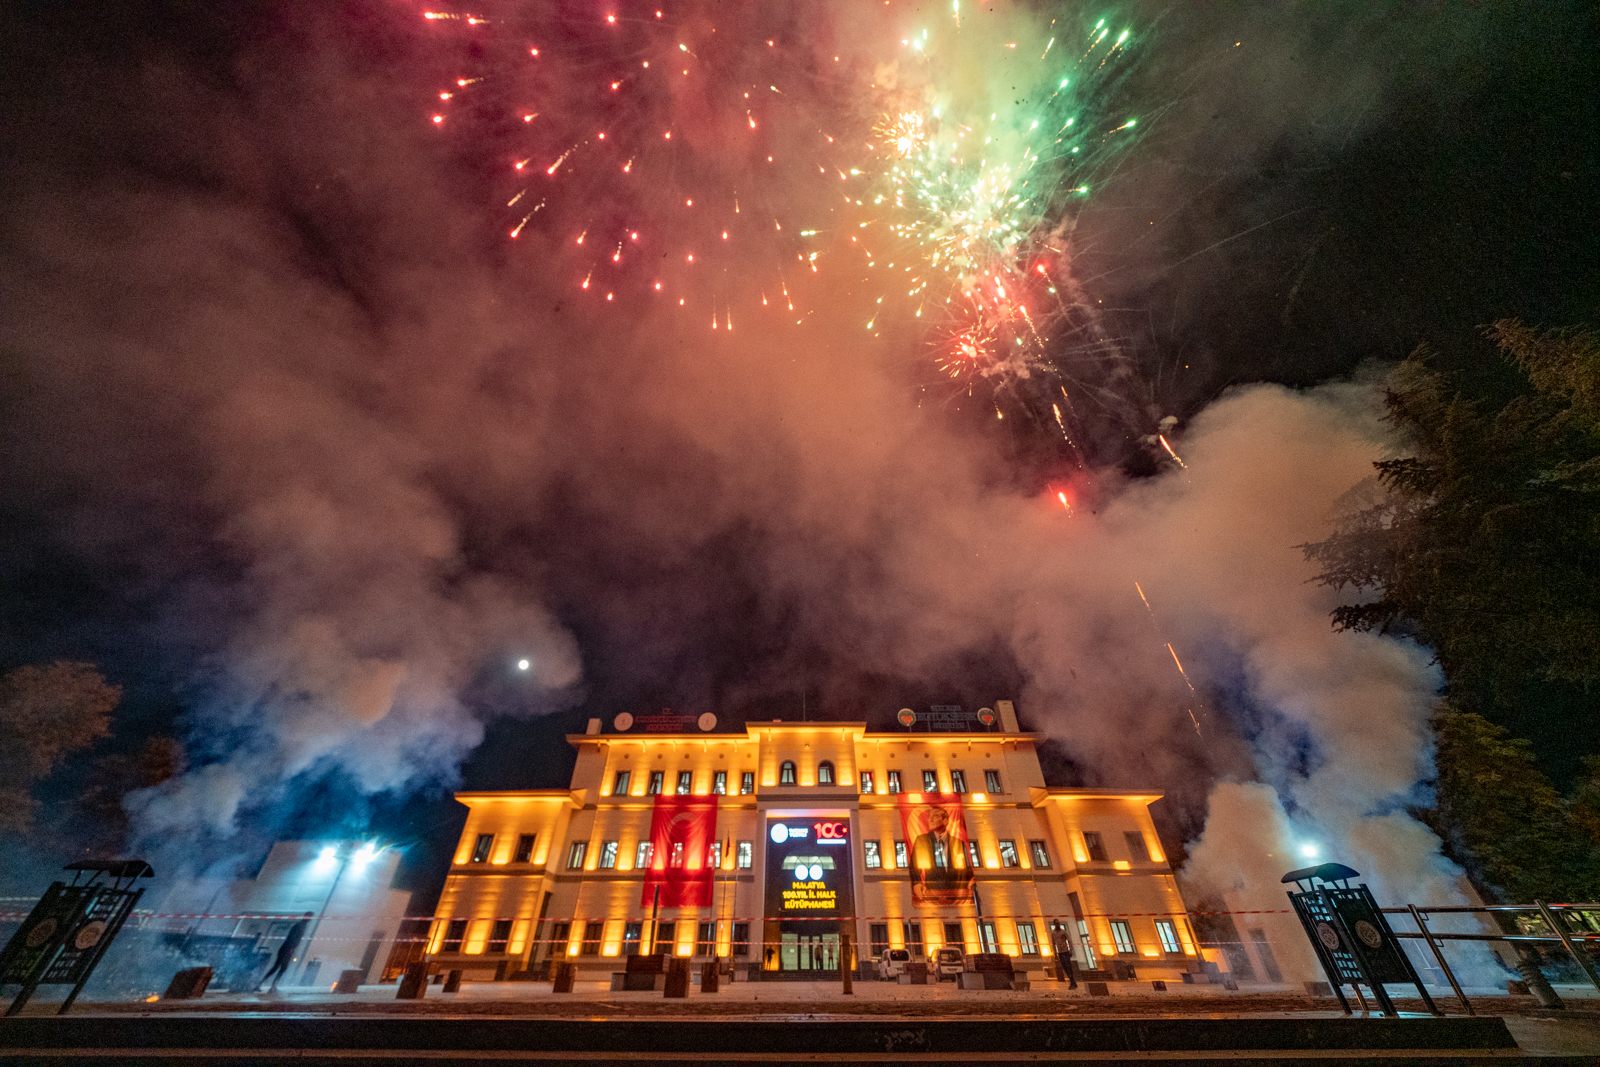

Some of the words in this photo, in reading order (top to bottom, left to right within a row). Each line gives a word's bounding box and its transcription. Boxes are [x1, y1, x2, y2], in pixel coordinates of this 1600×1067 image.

[792, 881, 826, 889] MALATYA
[808, 889, 816, 898] İL
[816, 890, 836, 899] HALK
[785, 899, 835, 909] KÜTÜPHANESİ
